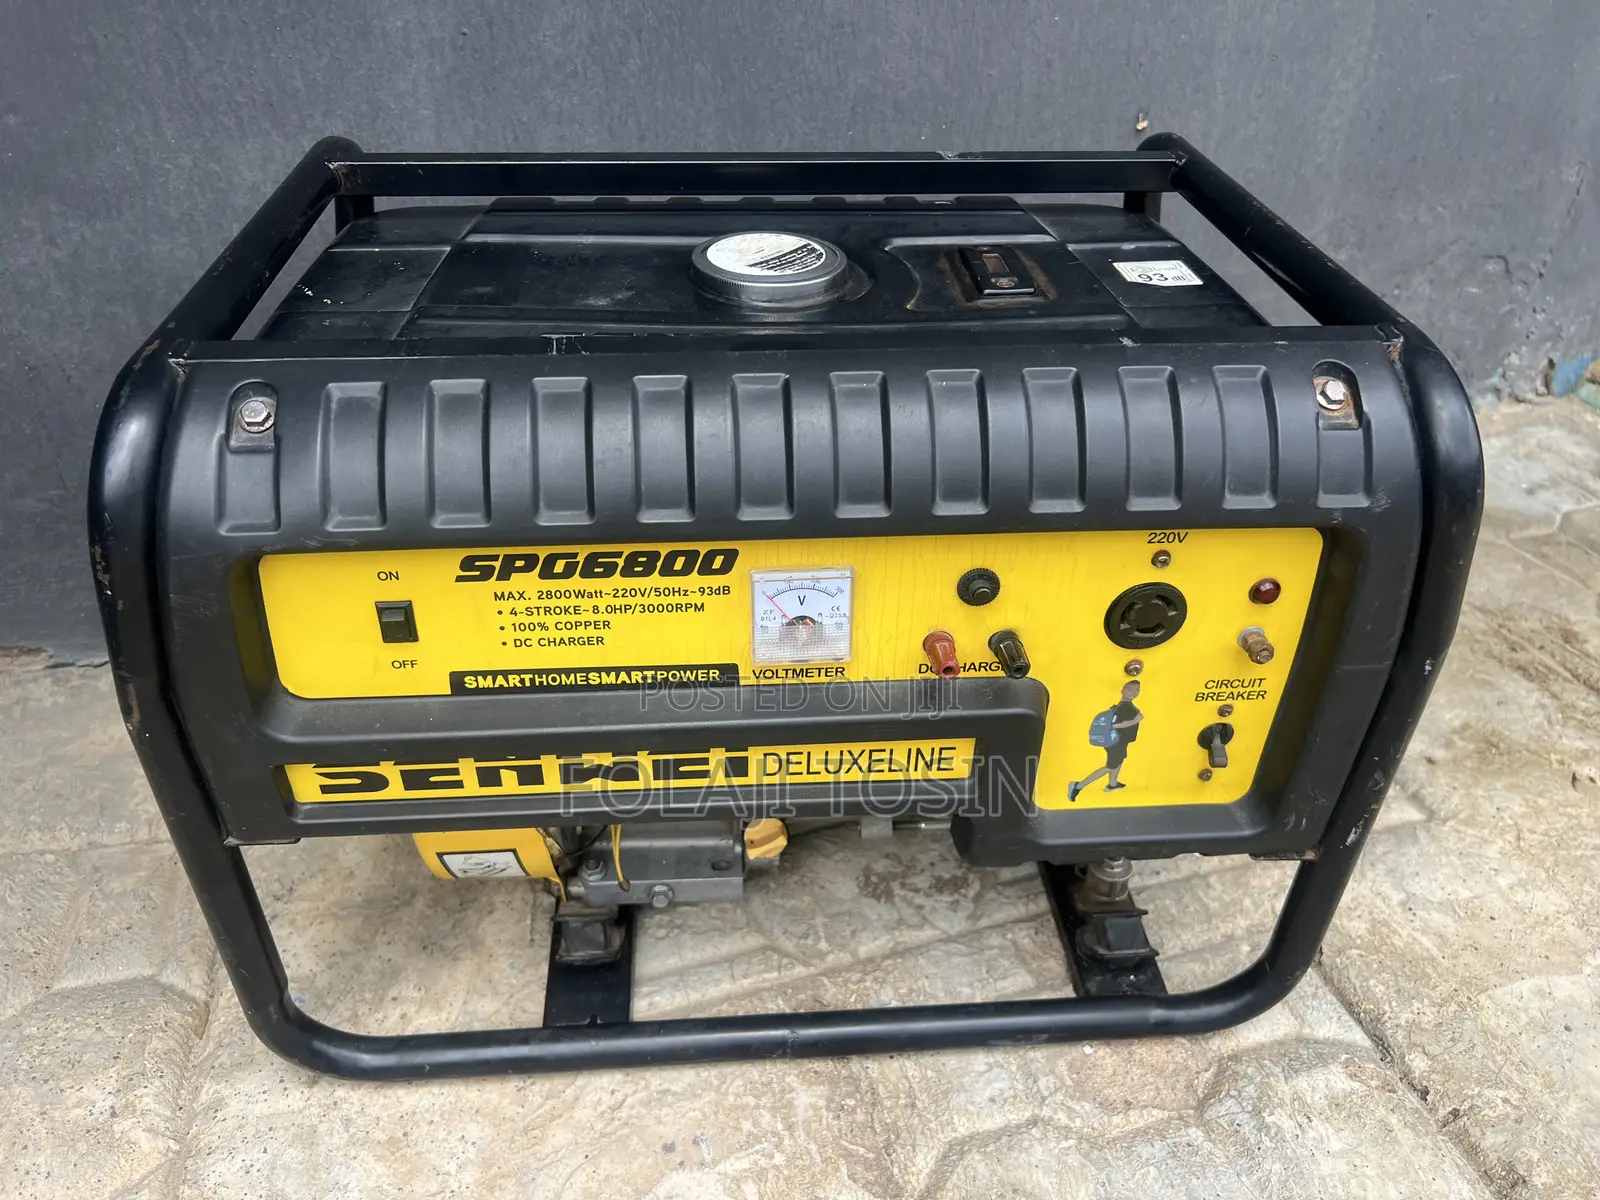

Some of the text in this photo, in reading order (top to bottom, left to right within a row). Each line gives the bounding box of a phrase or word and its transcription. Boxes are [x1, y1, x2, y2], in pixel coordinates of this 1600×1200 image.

[1137, 273, 1169, 282] 93
[1147, 532, 1189, 544] 220V
[455, 548, 740, 582] SPG6800
[377, 570, 400, 581] ON
[494, 590, 532, 601] MAX.
[797, 595, 807, 606] V
[512, 620, 612, 632] 100% COPPER
[514, 636, 605, 648] DC CHARGER
[391, 660, 418, 669] OFF
[464, 669, 720, 689] SMARTHOMESMARTPOWER
[752, 666, 846, 680] VOLTMETER
[1204, 677, 1267, 690] CIRCUIT
[1194, 690, 1268, 702] BREAKER
[763, 746, 957, 777] DELUXELINE
